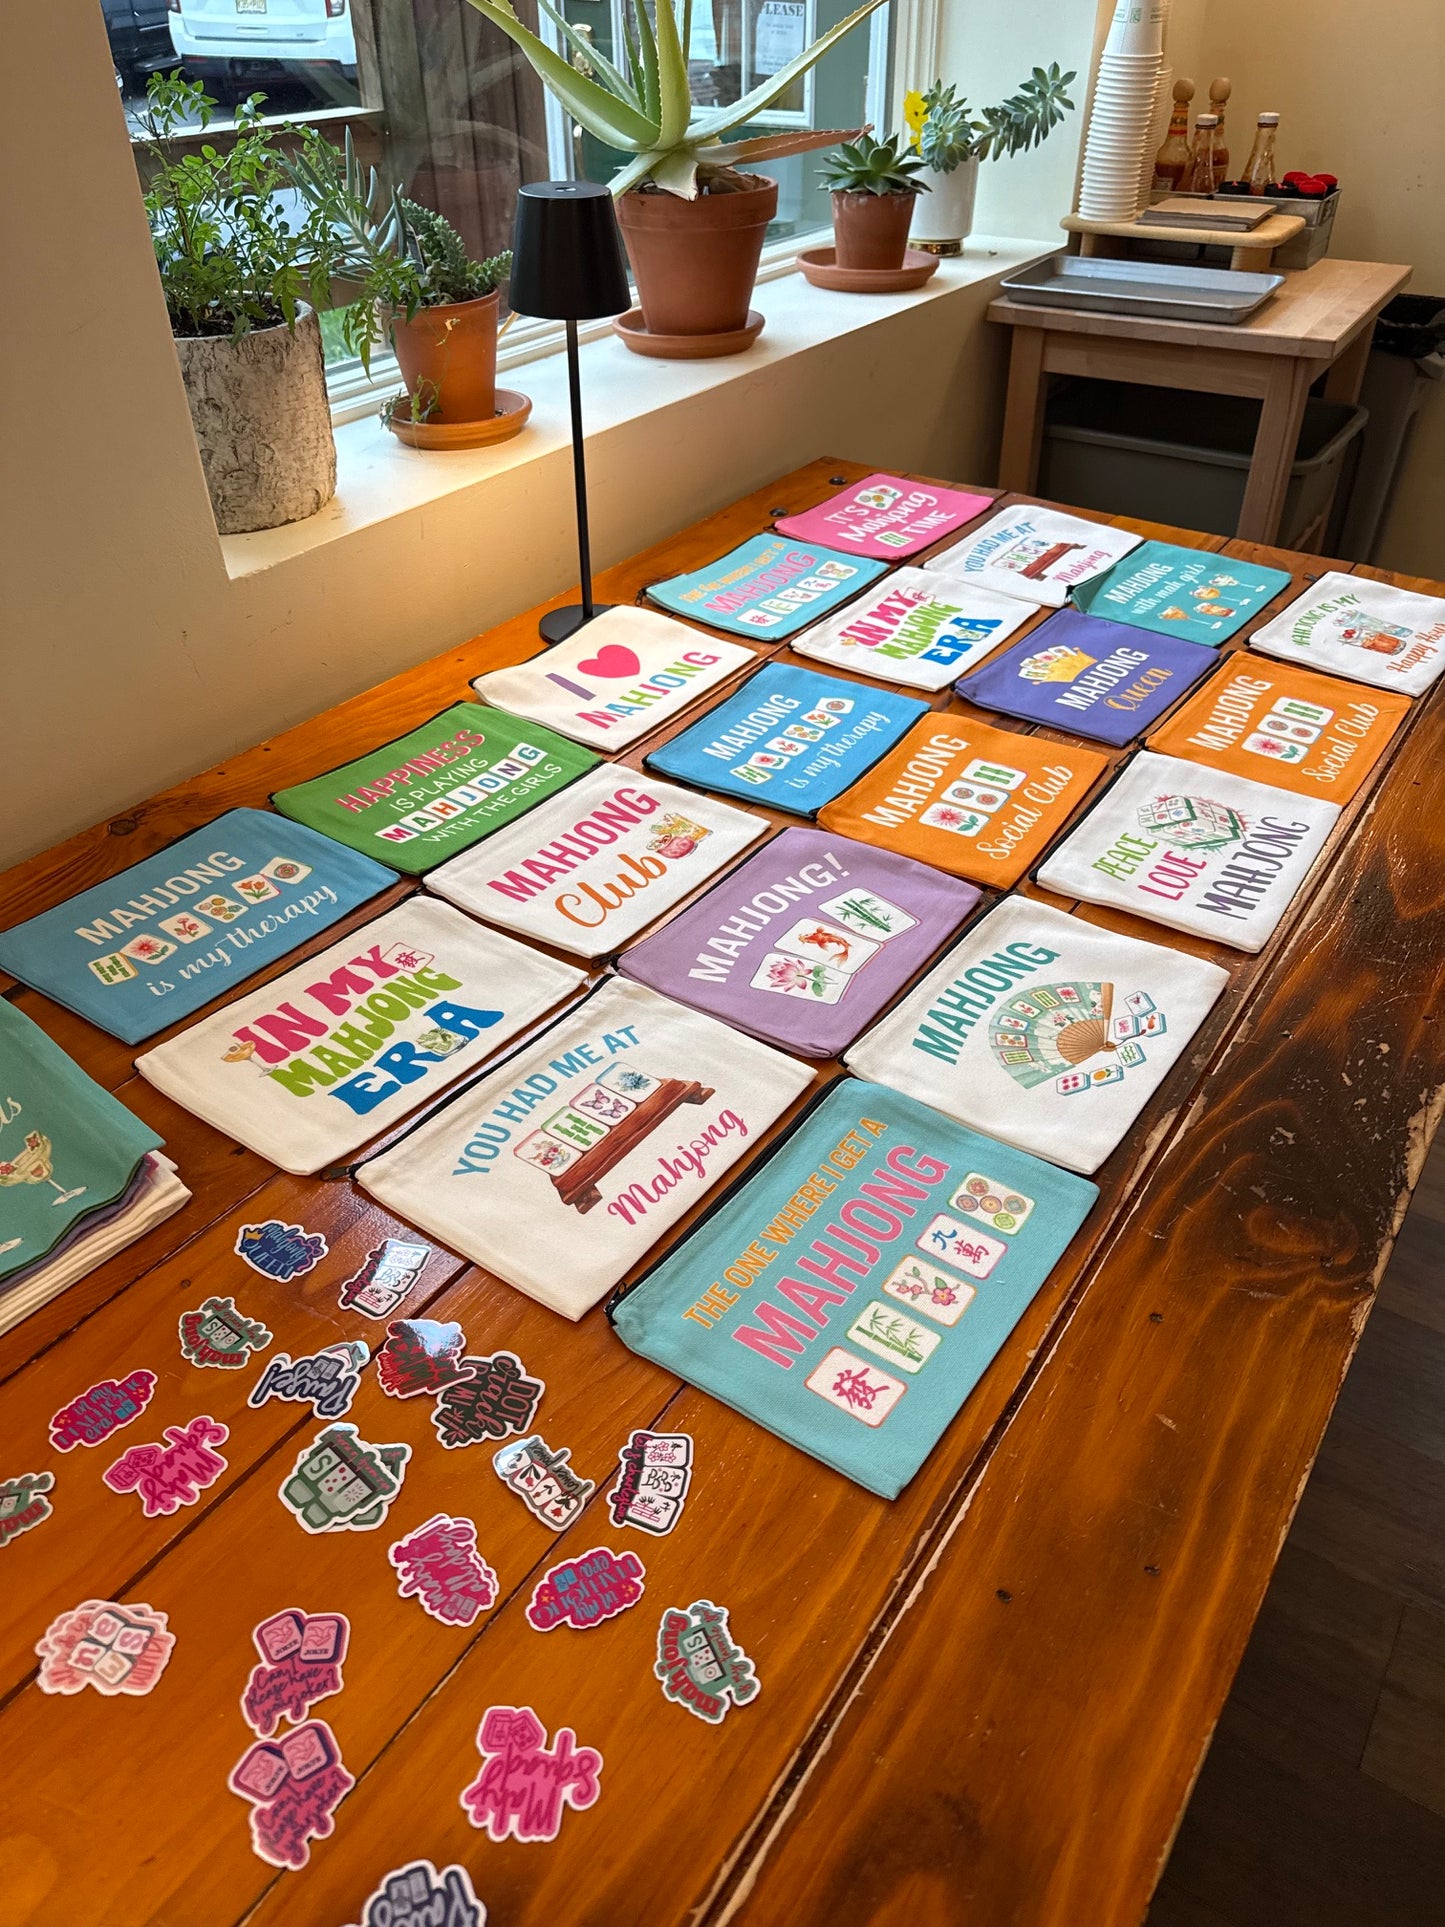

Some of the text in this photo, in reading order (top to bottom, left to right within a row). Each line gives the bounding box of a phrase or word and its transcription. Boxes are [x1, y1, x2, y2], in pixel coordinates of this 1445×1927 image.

[823, 505, 870, 525] IT'S
[836, 491, 939, 543] Mahjong
[899, 510, 957, 535] TIME
[964, 521, 1037, 573] YOU HAD ME AT
[703, 551, 818, 615] MAHJONG
[1052, 550, 1113, 583] Mahjong
[1103, 562, 1176, 605] MAHJONG
[1179, 563, 1207, 584] girls
[1317, 603, 1339, 613] IS
[1332, 593, 1362, 608] MY
[838, 589, 919, 647] IN MY
[873, 601, 964, 661] MAHJONG
[918, 617, 1004, 666] ERA
[575, 651, 723, 730] MAHJONG
[1054, 646, 1150, 711] MAHJONG
[1103, 666, 1174, 712] Queen
[1385, 641, 1439, 674] Happy
[702, 693, 802, 761] MAHJONG
[784, 711, 892, 789] is my therapy
[1186, 674, 1275, 752] MAHJONG
[1301, 701, 1380, 783] Social Club
[334, 729, 486, 814] HAPPINESS
[382, 746, 542, 841] MAHJONG
[389, 758, 489, 813] IS PLAYING
[422, 763, 563, 842] WITH THE GIRLS
[860, 733, 972, 829] MAHJONG
[485, 787, 662, 903] MAHJONG
[976, 763, 1073, 861] Social Club
[554, 853, 668, 928] Club
[1091, 832, 1158, 882] PEACE
[1137, 850, 1207, 901] LOVE
[1195, 816, 1311, 921] MAHJONG
[73, 851, 248, 946] MAHJONG
[687, 852, 851, 983] MAHJONG!
[146, 884, 338, 996] is my therapy
[231, 944, 400, 1064] IN MY
[268, 965, 464, 1098] MAHJONG
[911, 941, 1062, 1066] MAHJONG
[327, 1000, 505, 1116] ERA
[452, 1024, 641, 1177] YOU HAD ME AT
[607, 1108, 748, 1226] Mahjong
[682, 1116, 888, 1329] THE ONE WHERE I GET A
[731, 1144, 951, 1370] MAHJONG
[496, 1381, 537, 1428] DOT
[580, 1555, 610, 1578] era
[659, 1614, 721, 1716] mahjong
